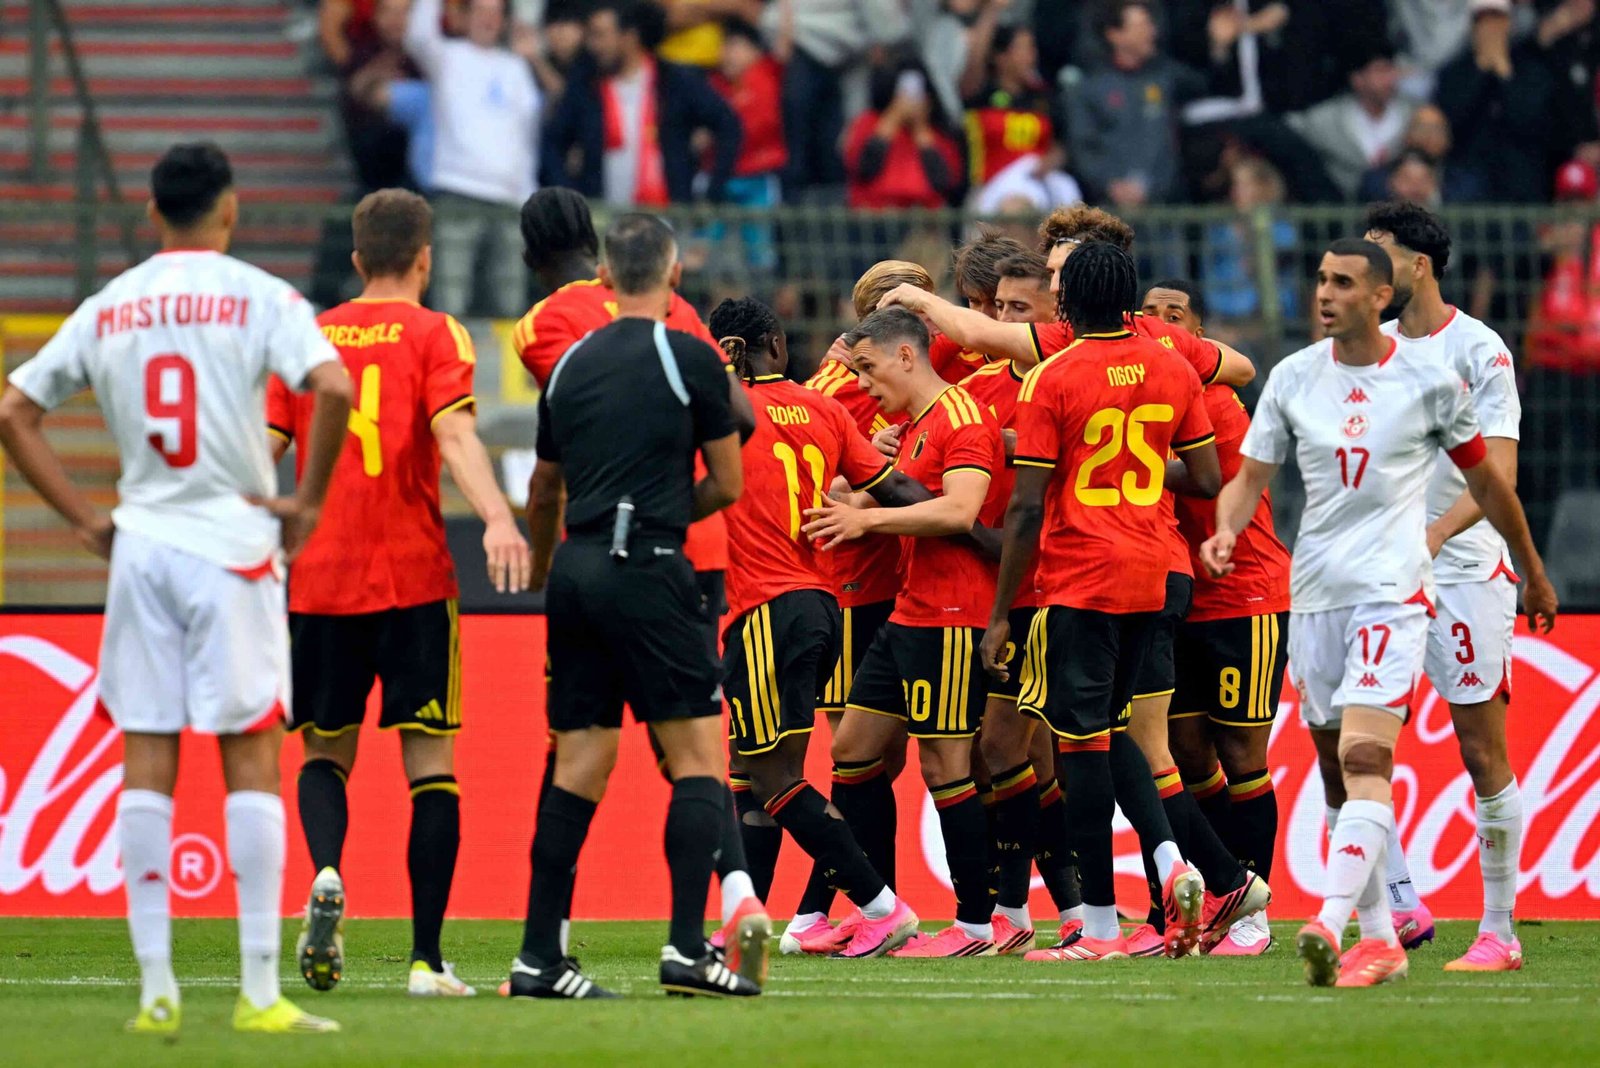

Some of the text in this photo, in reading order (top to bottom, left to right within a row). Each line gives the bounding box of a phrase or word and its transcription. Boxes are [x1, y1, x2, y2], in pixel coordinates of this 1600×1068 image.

[96, 294, 249, 339] MASTOURI
[1107, 363, 1146, 387] NGOY
[145, 353, 197, 469] 9
[343, 364, 383, 478] 4
[766, 405, 810, 426] DOKU
[1074, 404, 1174, 507] 25
[1335, 447, 1370, 490] 17
[773, 441, 825, 543] 11
[1357, 624, 1391, 666] 17
[1451, 622, 1475, 665] 3
[1220, 666, 1240, 709] 8
